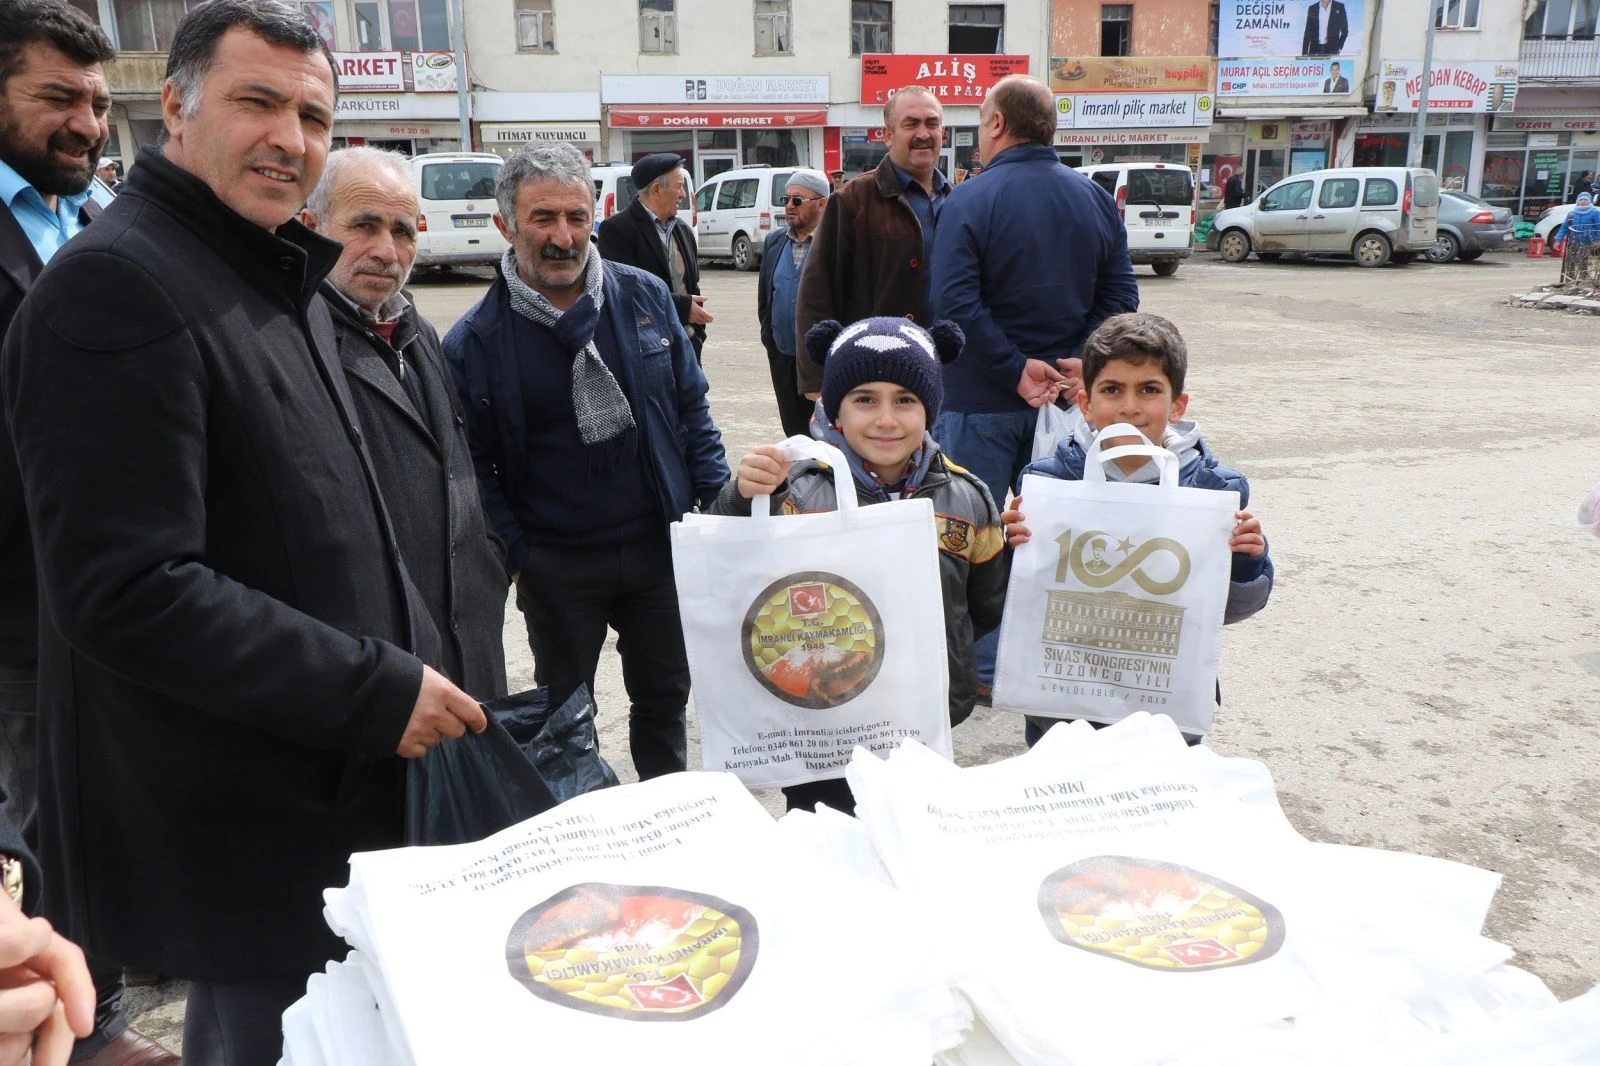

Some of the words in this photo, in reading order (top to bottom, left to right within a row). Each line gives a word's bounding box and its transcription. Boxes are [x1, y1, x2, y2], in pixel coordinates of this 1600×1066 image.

[1236, 2, 1285, 18] DEĞİŞİM
[915, 57, 976, 84] ALİŞ
[1220, 66, 1250, 77] MURAT
[1252, 66, 1271, 80] AÇIL
[1273, 64, 1300, 80] SEÇİM
[1302, 64, 1324, 76] OFİSİ
[716, 77, 762, 91] DOĞAN
[766, 79, 819, 92] MARKET
[1405, 68, 1451, 98] MEDAN
[1453, 68, 1487, 97] KEBAP
[1082, 99, 1120, 117] imranlı
[1122, 99, 1145, 120] piliç
[1149, 98, 1188, 116] market
[663, 113, 709, 125] DOĞAN
[723, 116, 774, 125] MARKET
[1515, 121, 1553, 129] OZAN
[1564, 121, 1597, 129] CAFE
[497, 129, 532, 140] İTİMAT
[535, 131, 587, 140] KUYUMCU
[1060, 132, 1100, 143] İMRANLI
[1102, 132, 1126, 144] PİLİÇ
[1128, 133, 1169, 142] MARKET
[800, 618, 824, 628] T.C.
[757, 633, 796, 645] İMRANLI
[797, 624, 867, 642] KAYMAKAMLIĞI
[801, 642, 826, 652] 1948
[1043, 647, 1081, 664] SİVAS
[1083, 651, 1172, 676] KONGRESİ'NİN
[1135, 673, 1171, 689] YILI
[1140, 694, 1168, 705] 2019
[731, 744, 766, 756] Telefon:
[767, 742, 787, 753] 0346
[788, 740, 804, 750] 861
[806, 739, 817, 749] 20
[818, 738, 829, 748] 08
[836, 736, 856, 748] Fax:
[857, 732, 878, 743] 0346
[879, 730, 895, 739] 861
[897, 729, 908, 738] 33
[910, 728, 921, 737] 99
[757, 729, 787, 740] E-mail
[724, 754, 770, 771] Karşıyaka
[771, 752, 794, 765] Mah.
[794, 748, 836, 761] Hükümet
[1022, 780, 1086, 800] İMRANLI
[1107, 789, 1139, 805] Mah.
[1049, 795, 1105, 811] Hükümet
[1151, 798, 1198, 814] Telefon:
[1120, 804, 1150, 819] 0346
[631, 828, 663, 845] 0346
[489, 855, 523, 875] 0346
